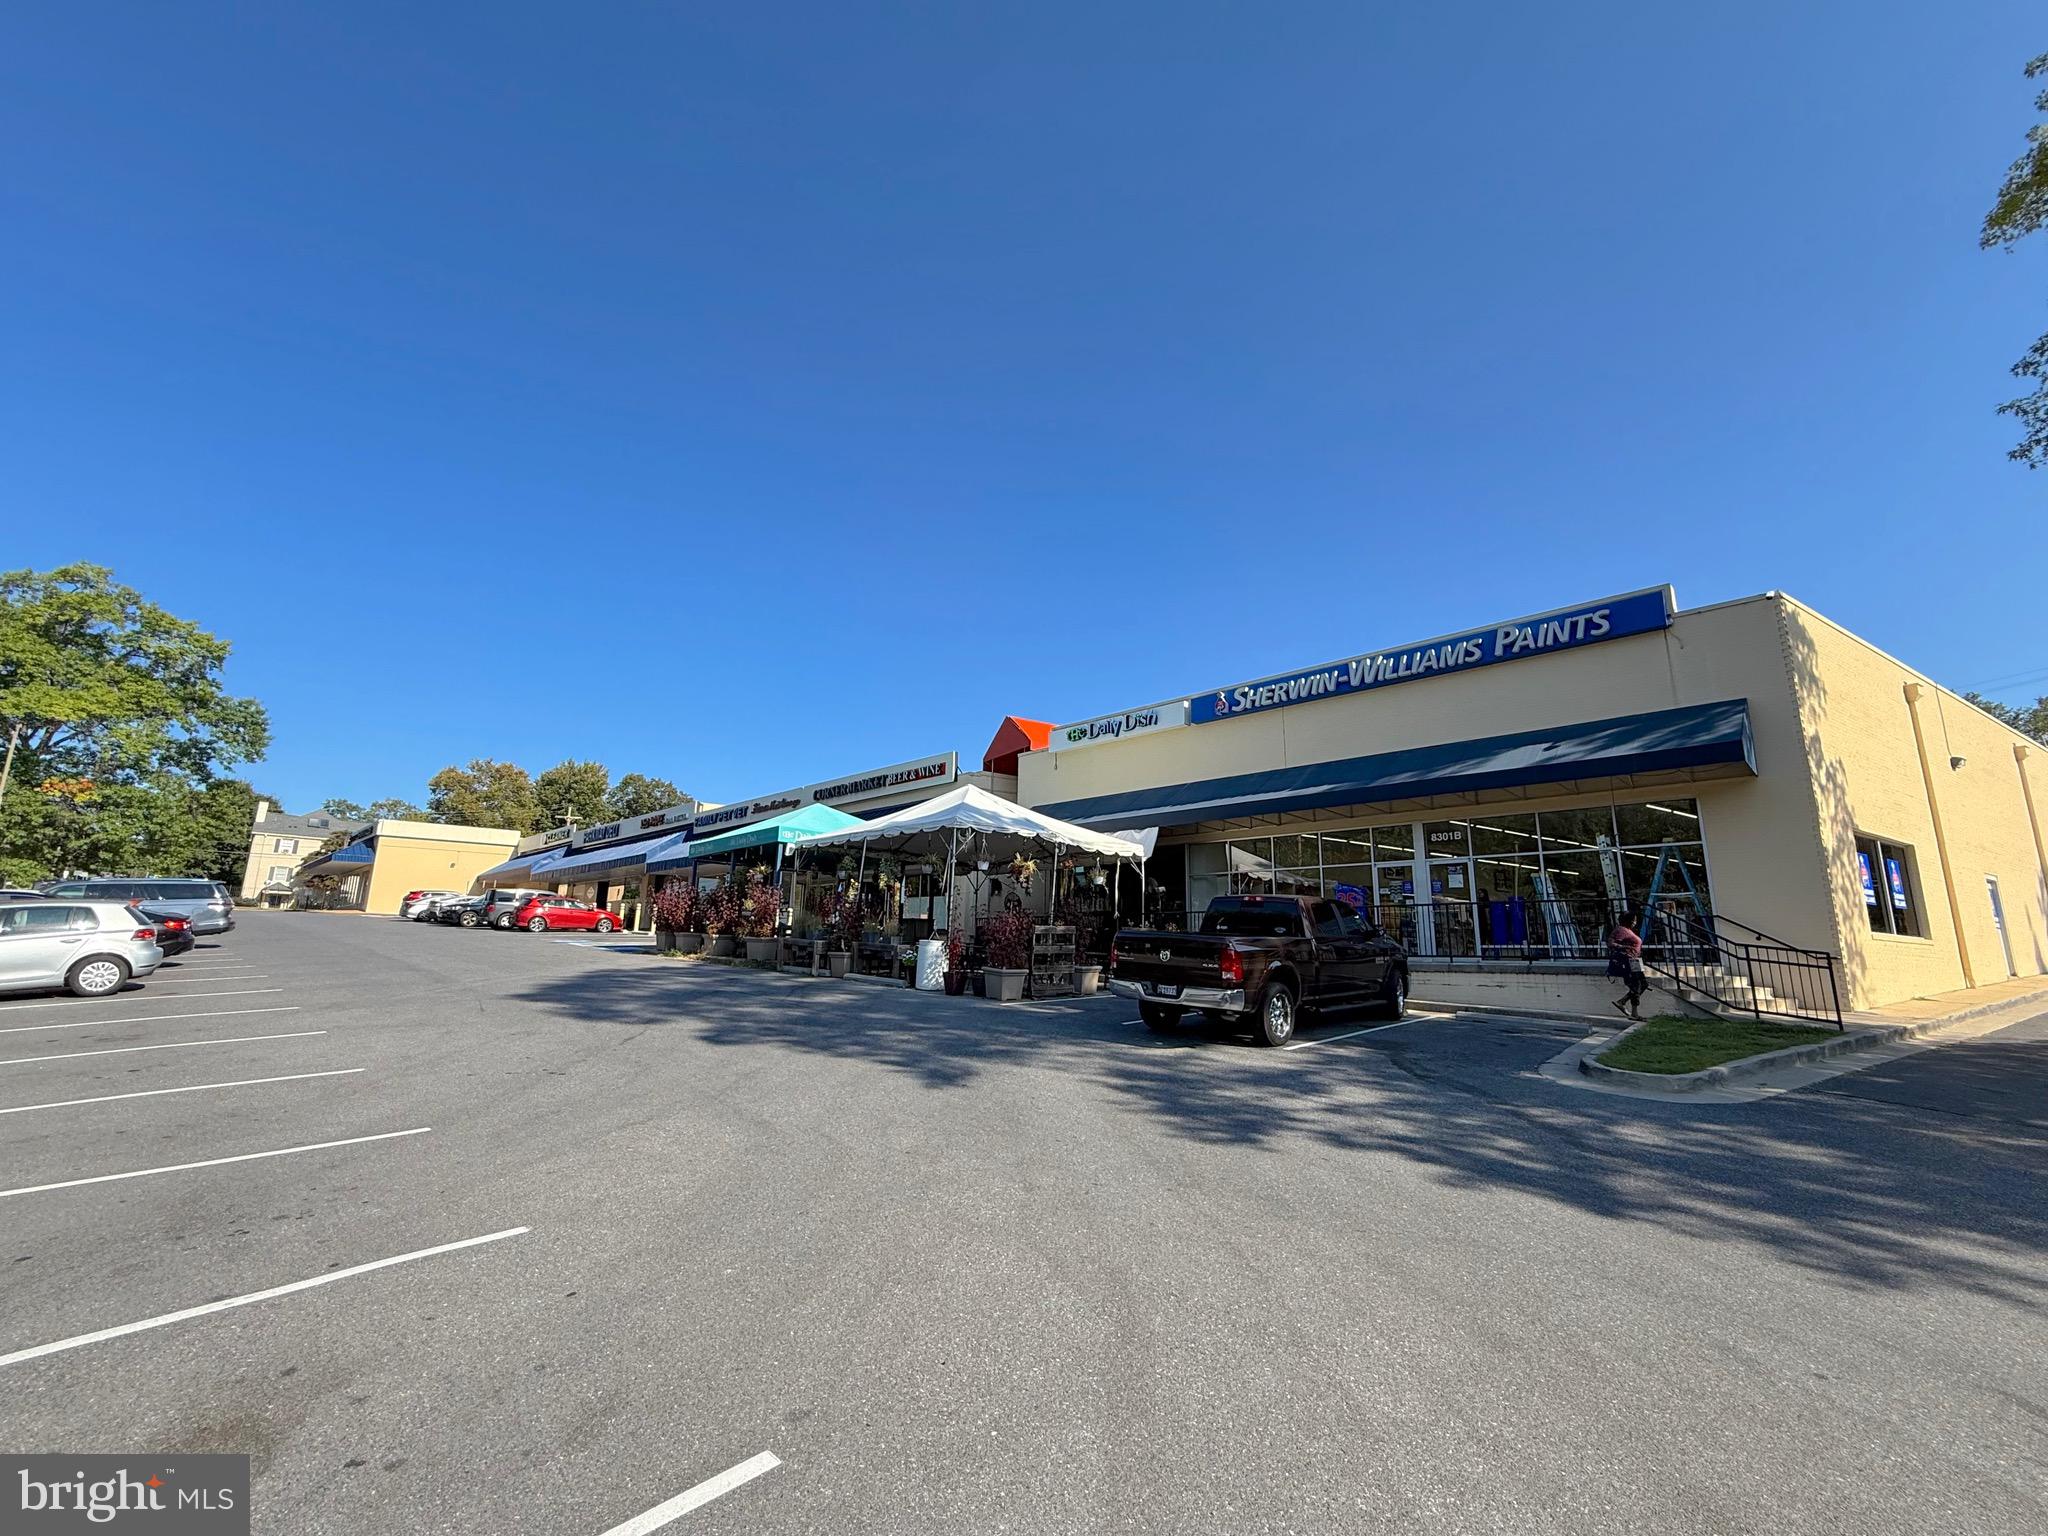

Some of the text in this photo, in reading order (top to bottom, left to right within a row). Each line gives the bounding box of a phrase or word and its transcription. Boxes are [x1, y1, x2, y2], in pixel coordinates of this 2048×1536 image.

[1494, 608, 1611, 657] PAINTS
[1087, 719, 1122, 740] Daily
[1122, 709, 1158, 732] Dish
[813, 763, 941, 801] CORNER MARKET BEER & WINE
[695, 813, 719, 828] FAMILY
[1430, 831, 1462, 842] 8301B
